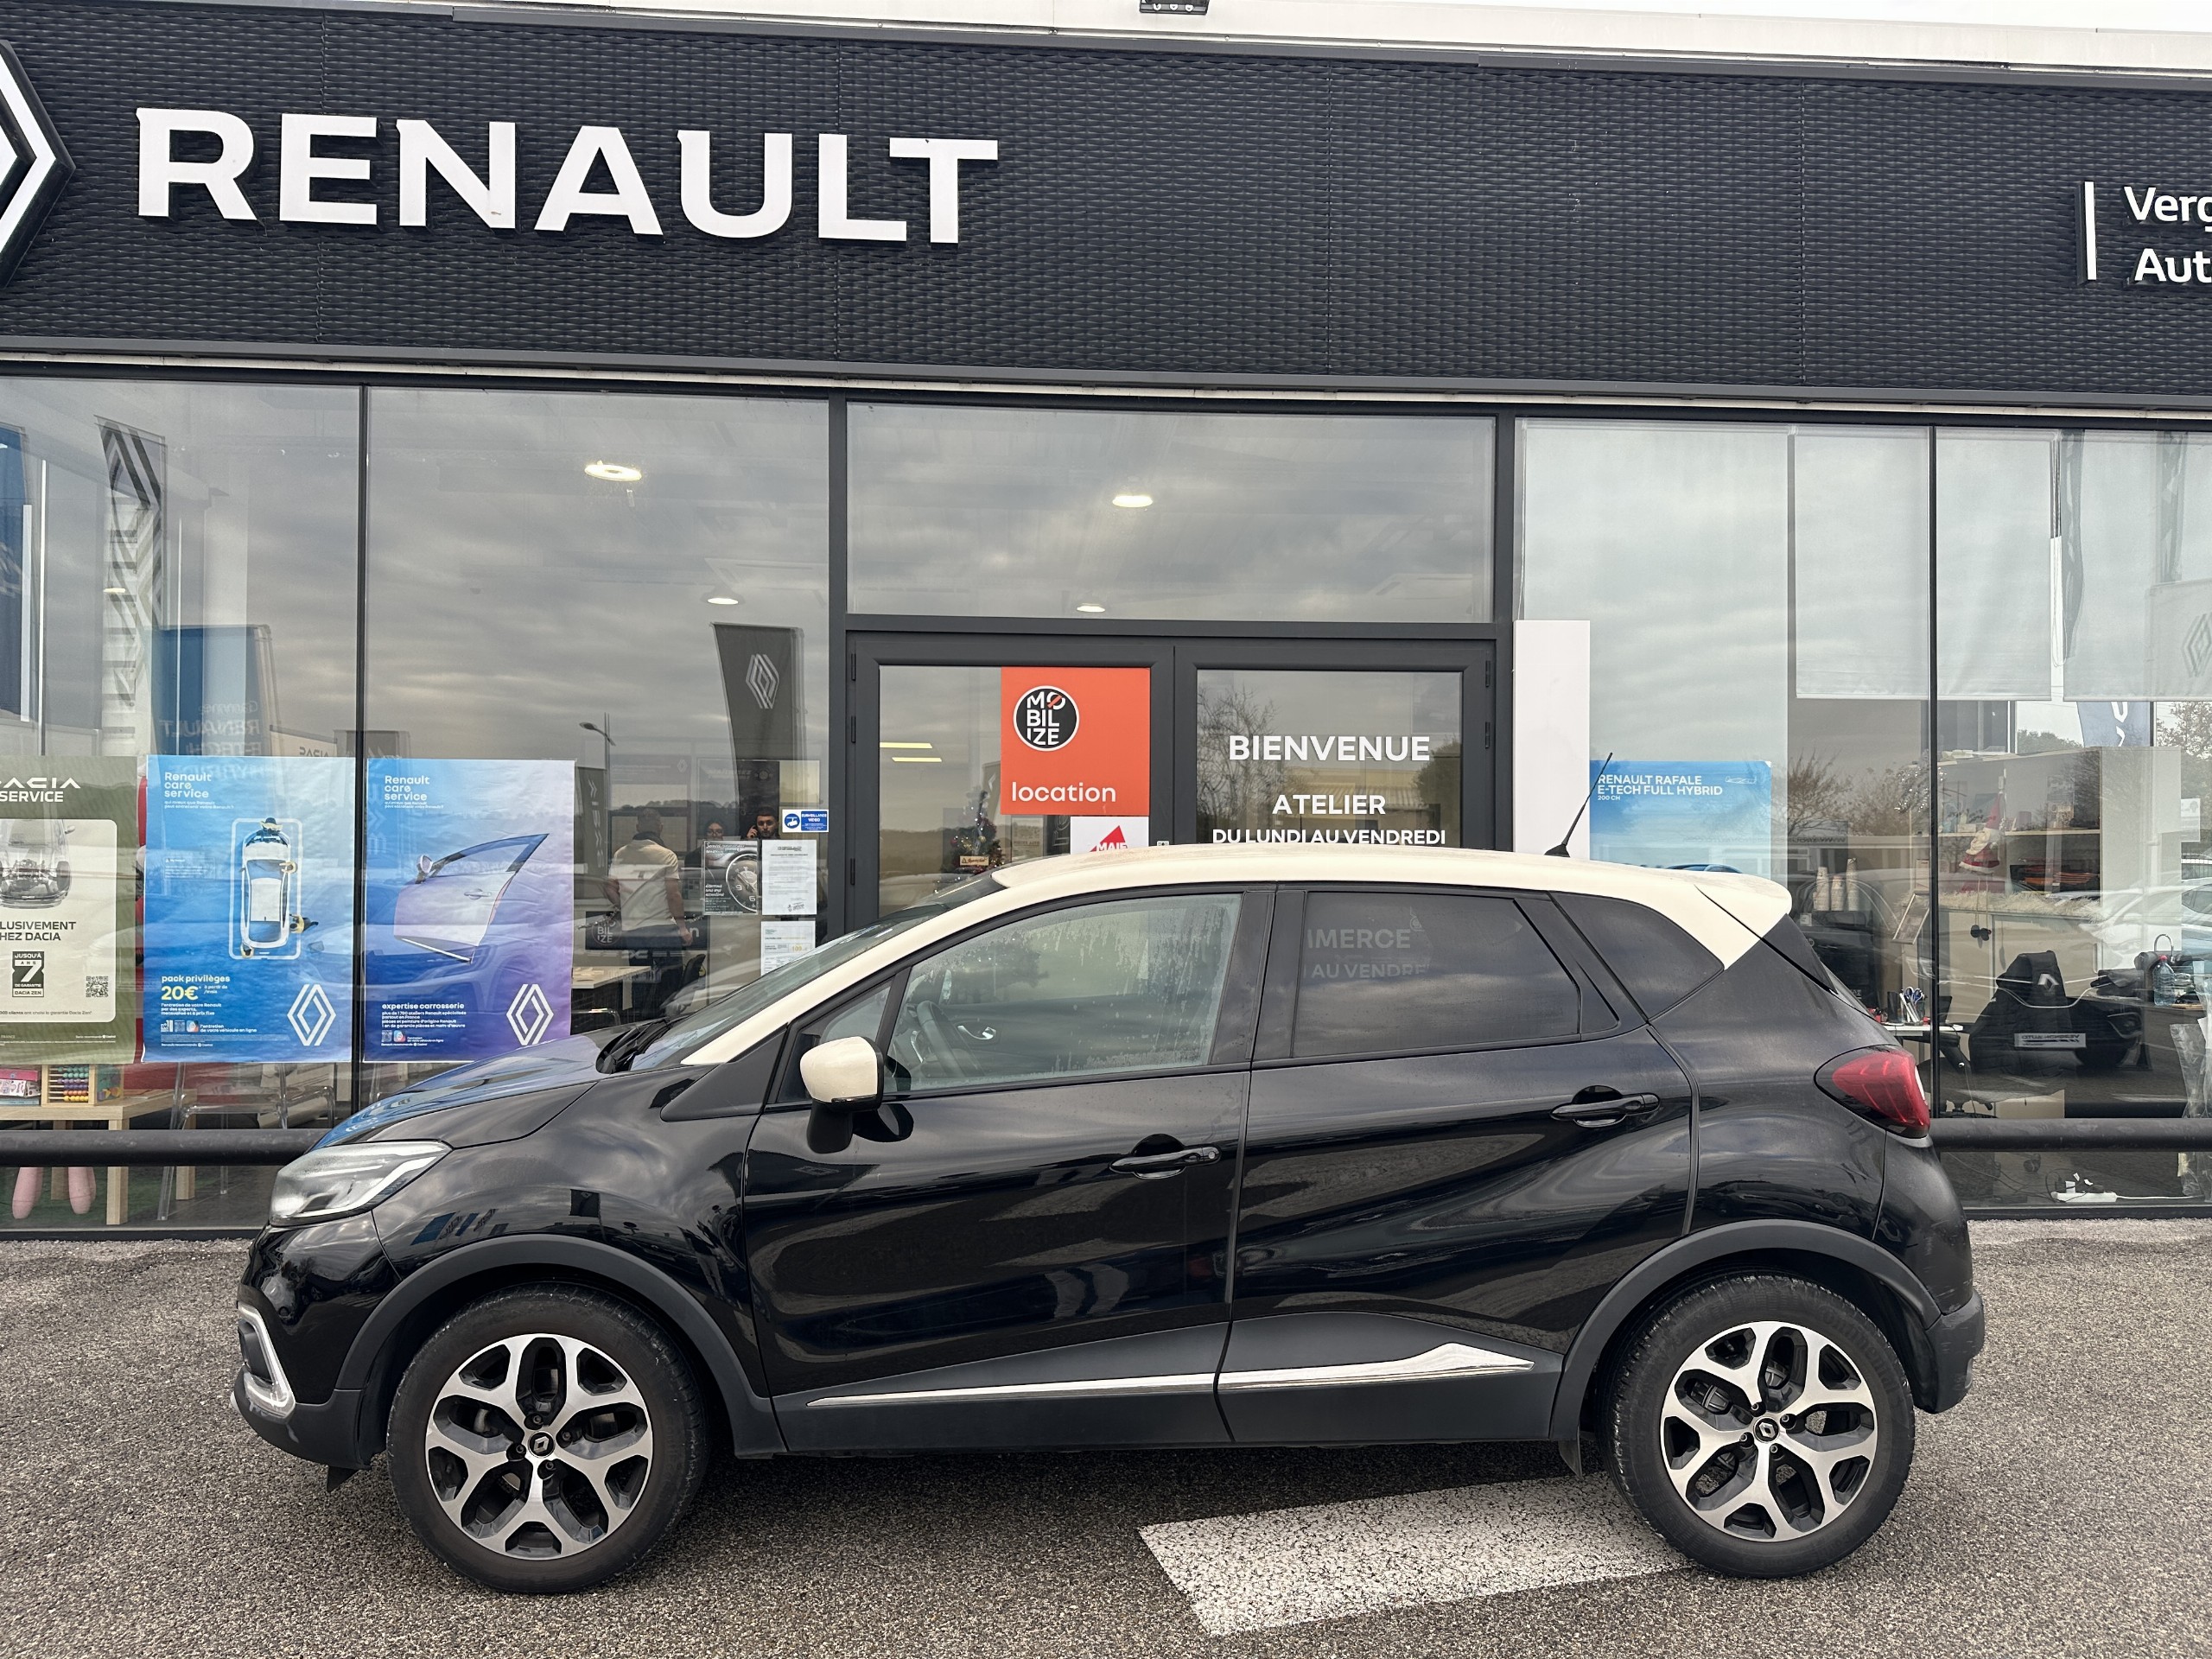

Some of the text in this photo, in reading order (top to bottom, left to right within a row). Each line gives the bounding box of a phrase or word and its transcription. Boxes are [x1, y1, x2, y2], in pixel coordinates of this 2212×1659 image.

[136, 107, 999, 245] RENAULT
[2134, 248, 2212, 283] Aut
[1027, 709, 1059, 727] BIL
[1027, 728, 1059, 746] IZE
[1230, 735, 1430, 761] BIENVENUE
[0, 777, 81, 788] ACIA
[164, 772, 212, 782] Renault
[385, 775, 430, 785] Renault
[1598, 775, 1702, 785] RENAULT RAFALE
[164, 789, 209, 798] service
[384, 791, 428, 801] service
[1012, 781, 1116, 803] location
[1598, 785, 1723, 796] E-TECH FULL HYBRID
[0, 791, 64, 803] SERVICE
[1272, 794, 1386, 815] ATELIER
[1212, 829, 1446, 845] DU LUNDI AU VENDREDI
[25, 932, 61, 941] DACIA
[14, 959, 42, 982] 7
[162, 975, 231, 984] pack privilèges
